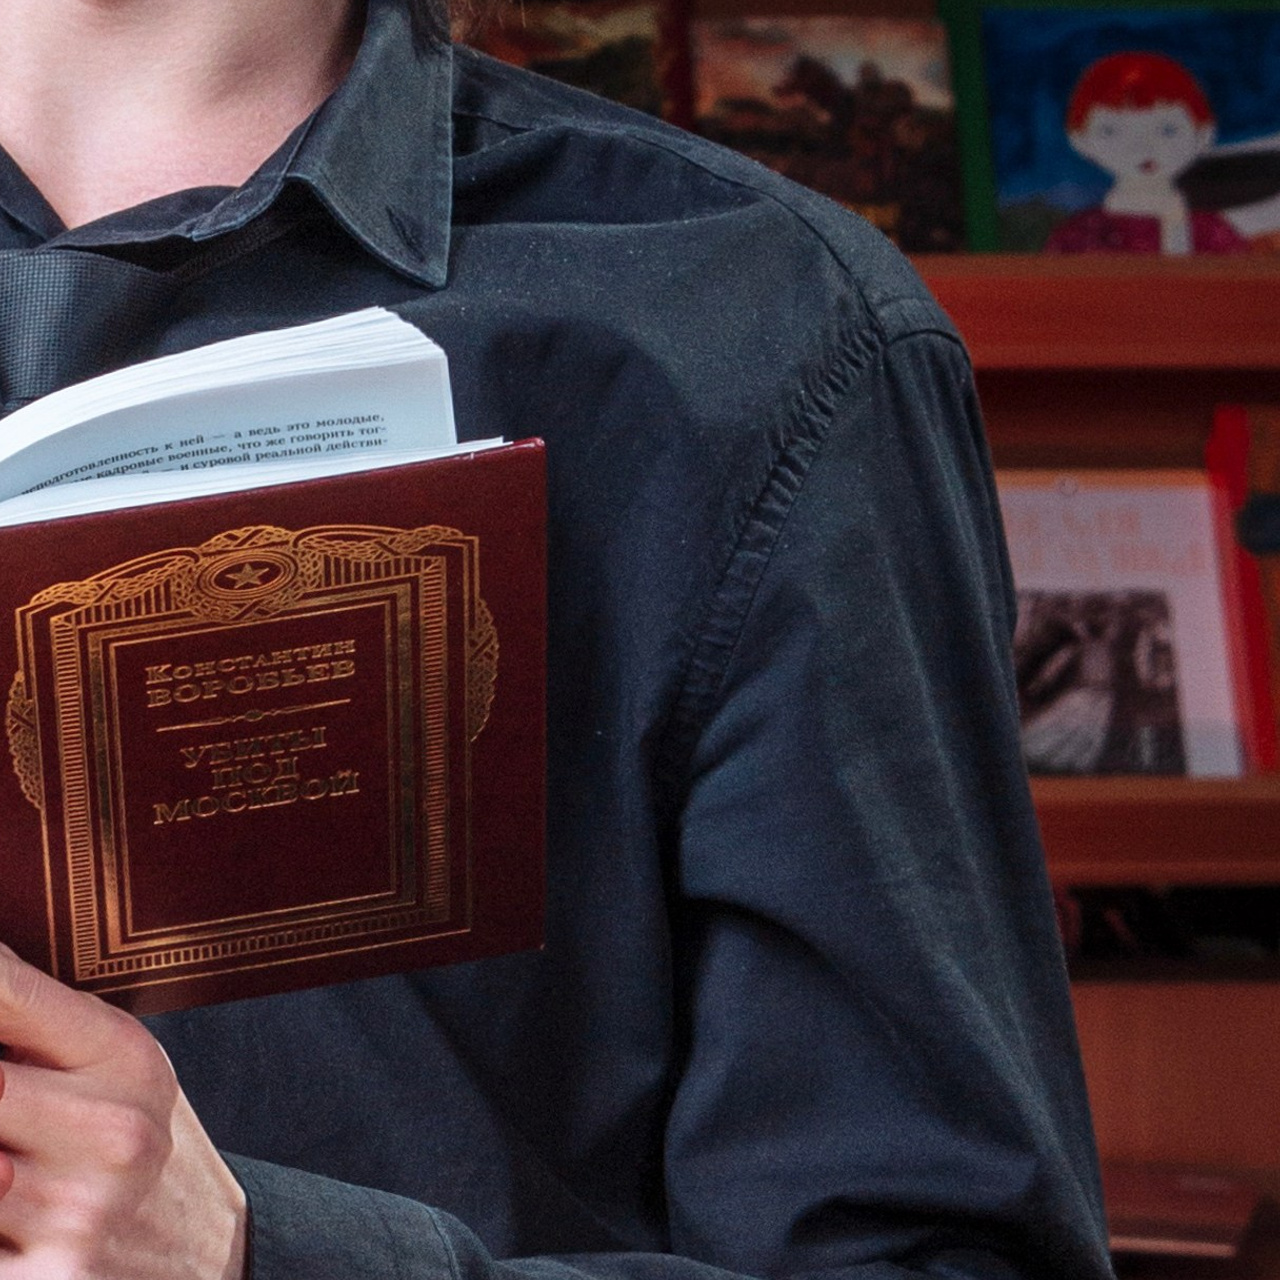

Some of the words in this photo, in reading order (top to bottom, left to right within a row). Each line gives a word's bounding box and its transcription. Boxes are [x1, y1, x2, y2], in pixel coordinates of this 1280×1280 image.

[96, 456, 165, 479] кадровые
[168, 444, 233, 462] военные,
[237, 440, 262, 451] что
[266, 437, 286, 448] же
[290, 428, 355, 445] говорить
[359, 424, 387, 436] тог-
[164, 442, 174, 451] к
[179, 434, 205, 448] ней
[234, 430, 243, 439] а
[248, 424, 281, 437] ведь
[287, 421, 311, 432] это
[315, 413, 385, 429] молодые,
[180, 462, 190, 471] и
[193, 453, 252, 471] суровой
[255, 442, 322, 463] реальной
[325, 437, 389, 453] действи-
[180, 726, 327, 769] УБИТЫ
[211, 756, 301, 790] ПОД
[153, 769, 361, 825] МОСКВОЙ
